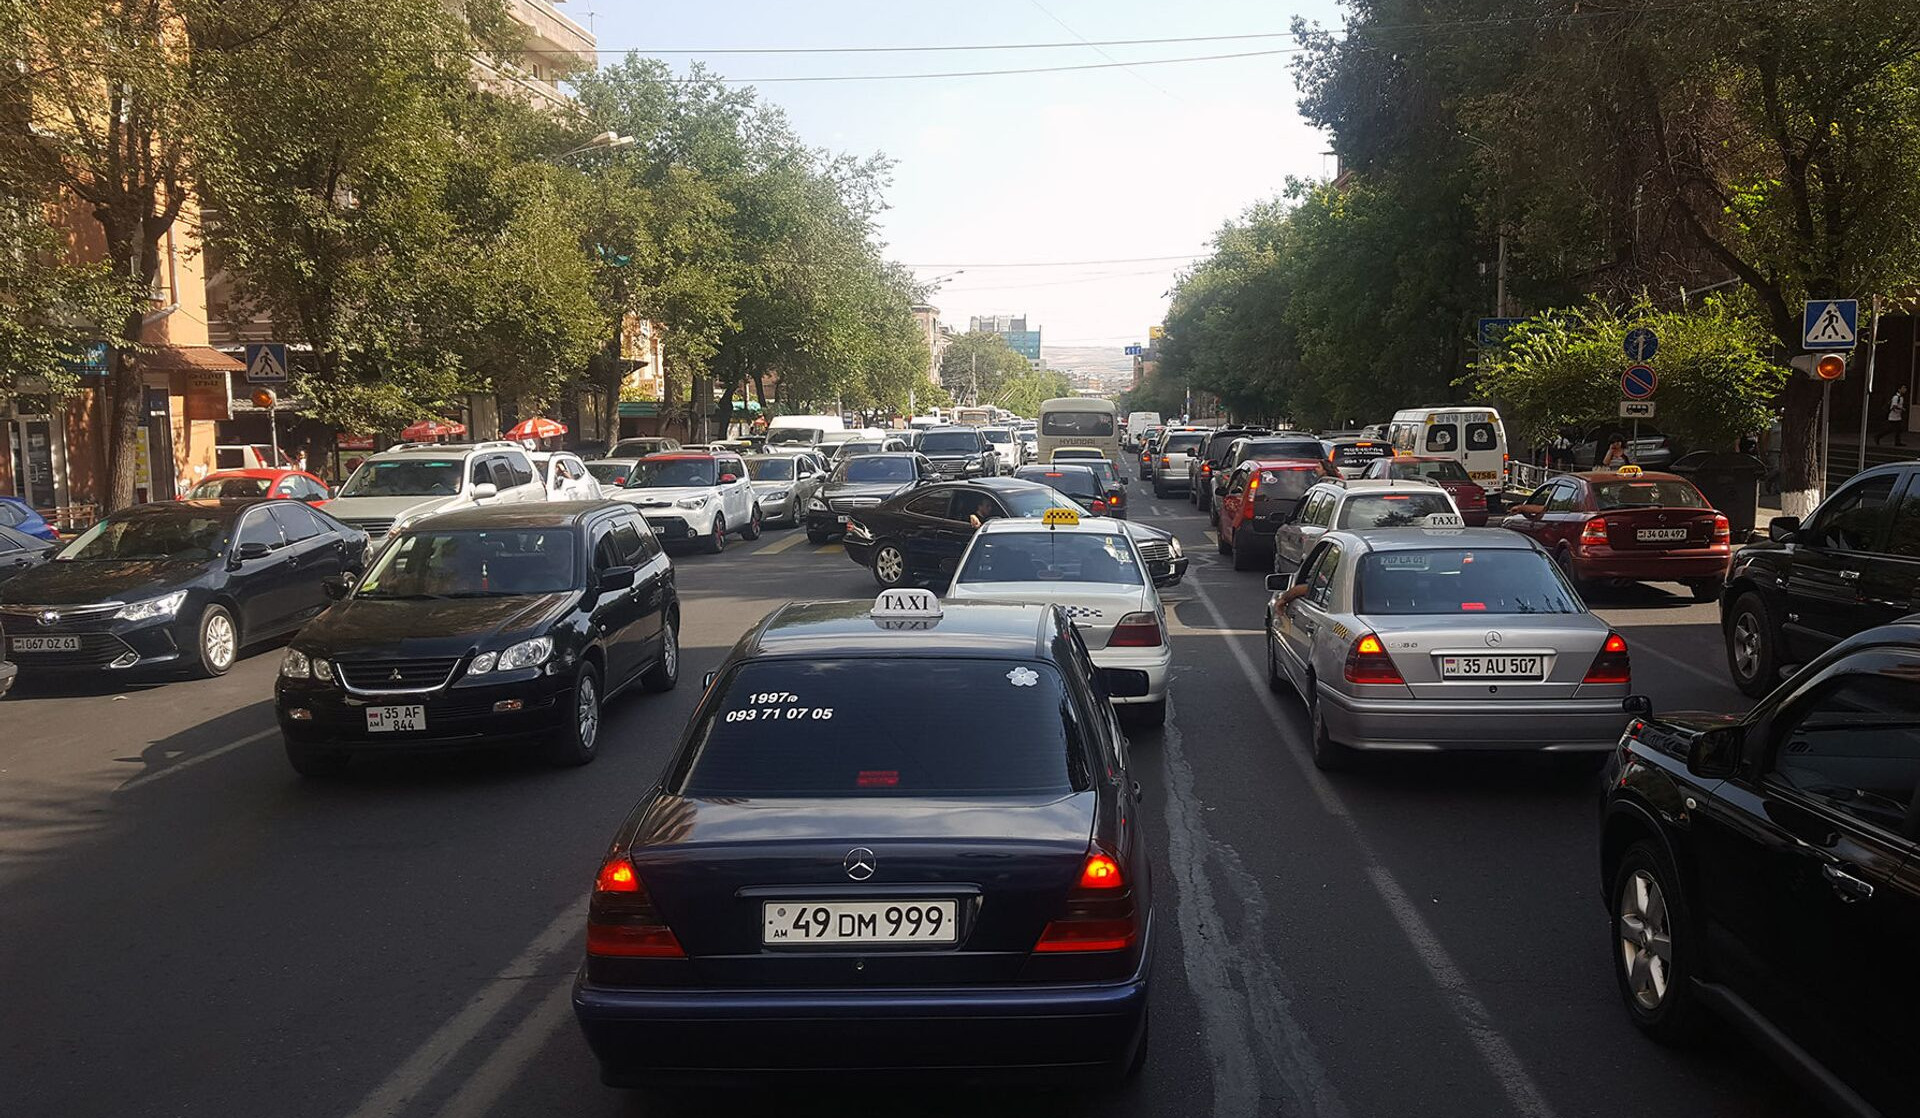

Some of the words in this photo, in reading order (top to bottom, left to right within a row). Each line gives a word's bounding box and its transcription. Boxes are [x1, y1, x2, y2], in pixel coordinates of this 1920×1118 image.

[1060, 438, 1096, 446] HYUNDAI
[1431, 516, 1458, 525] TAXI
[1647, 530, 1656, 538] 34
[1672, 530, 1685, 538] 492
[882, 595, 929, 610] TAXI
[26, 639, 43, 649] 067
[64, 638, 76, 648] 61
[1464, 659, 1480, 674] 35
[1486, 659, 1506, 673] AU
[1511, 658, 1536, 674] 507
[384, 707, 399, 719] 35
[404, 707, 421, 718] AF
[726, 709, 758, 722] 093
[762, 708, 781, 720] 71
[786, 708, 808, 719] 07
[812, 708, 834, 719] 05
[393, 720, 414, 731] 844
[792, 907, 831, 938] 49
[838, 913, 877, 938] DM
[885, 906, 944, 937] 999
[773, 929, 788, 938] AM
